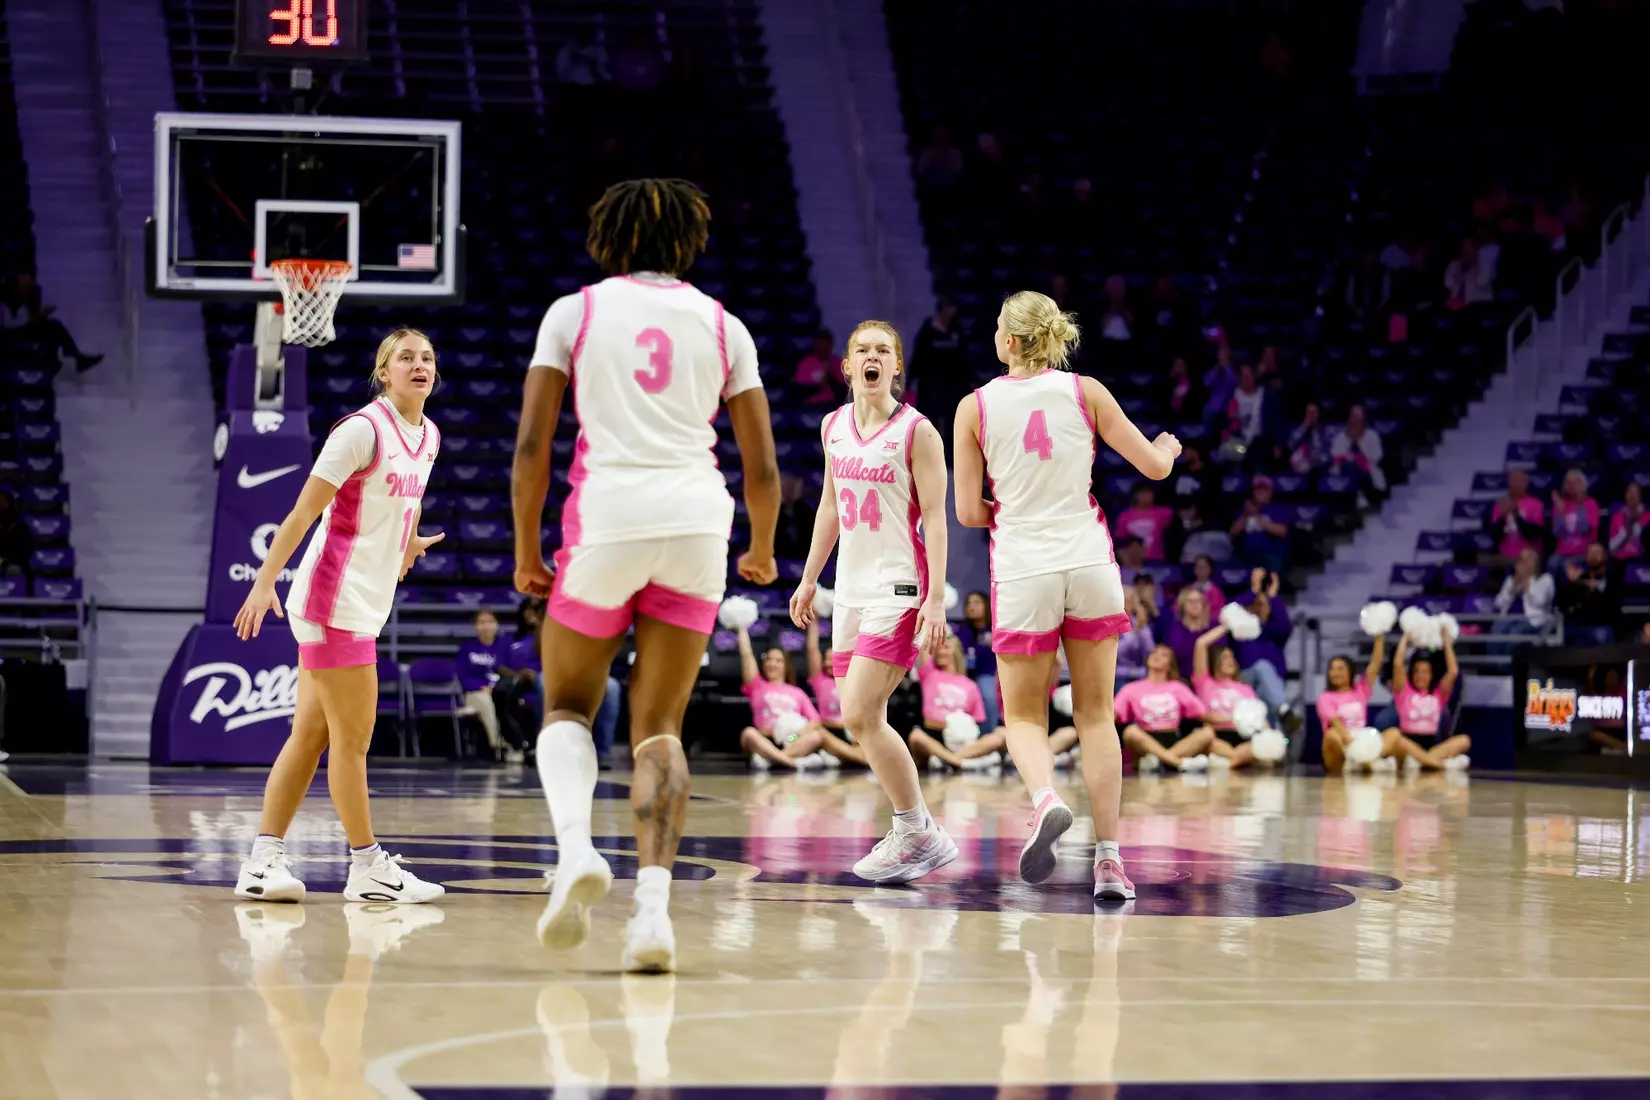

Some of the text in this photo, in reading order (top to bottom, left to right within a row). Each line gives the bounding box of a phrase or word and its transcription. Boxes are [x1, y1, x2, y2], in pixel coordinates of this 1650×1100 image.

[268, 0, 338, 46] 30
[633, 327, 673, 394] 3
[1022, 409, 1053, 461] 4
[831, 455, 896, 484] Wildcats
[840, 487, 883, 532] 34
[182, 661, 299, 726] Dill
